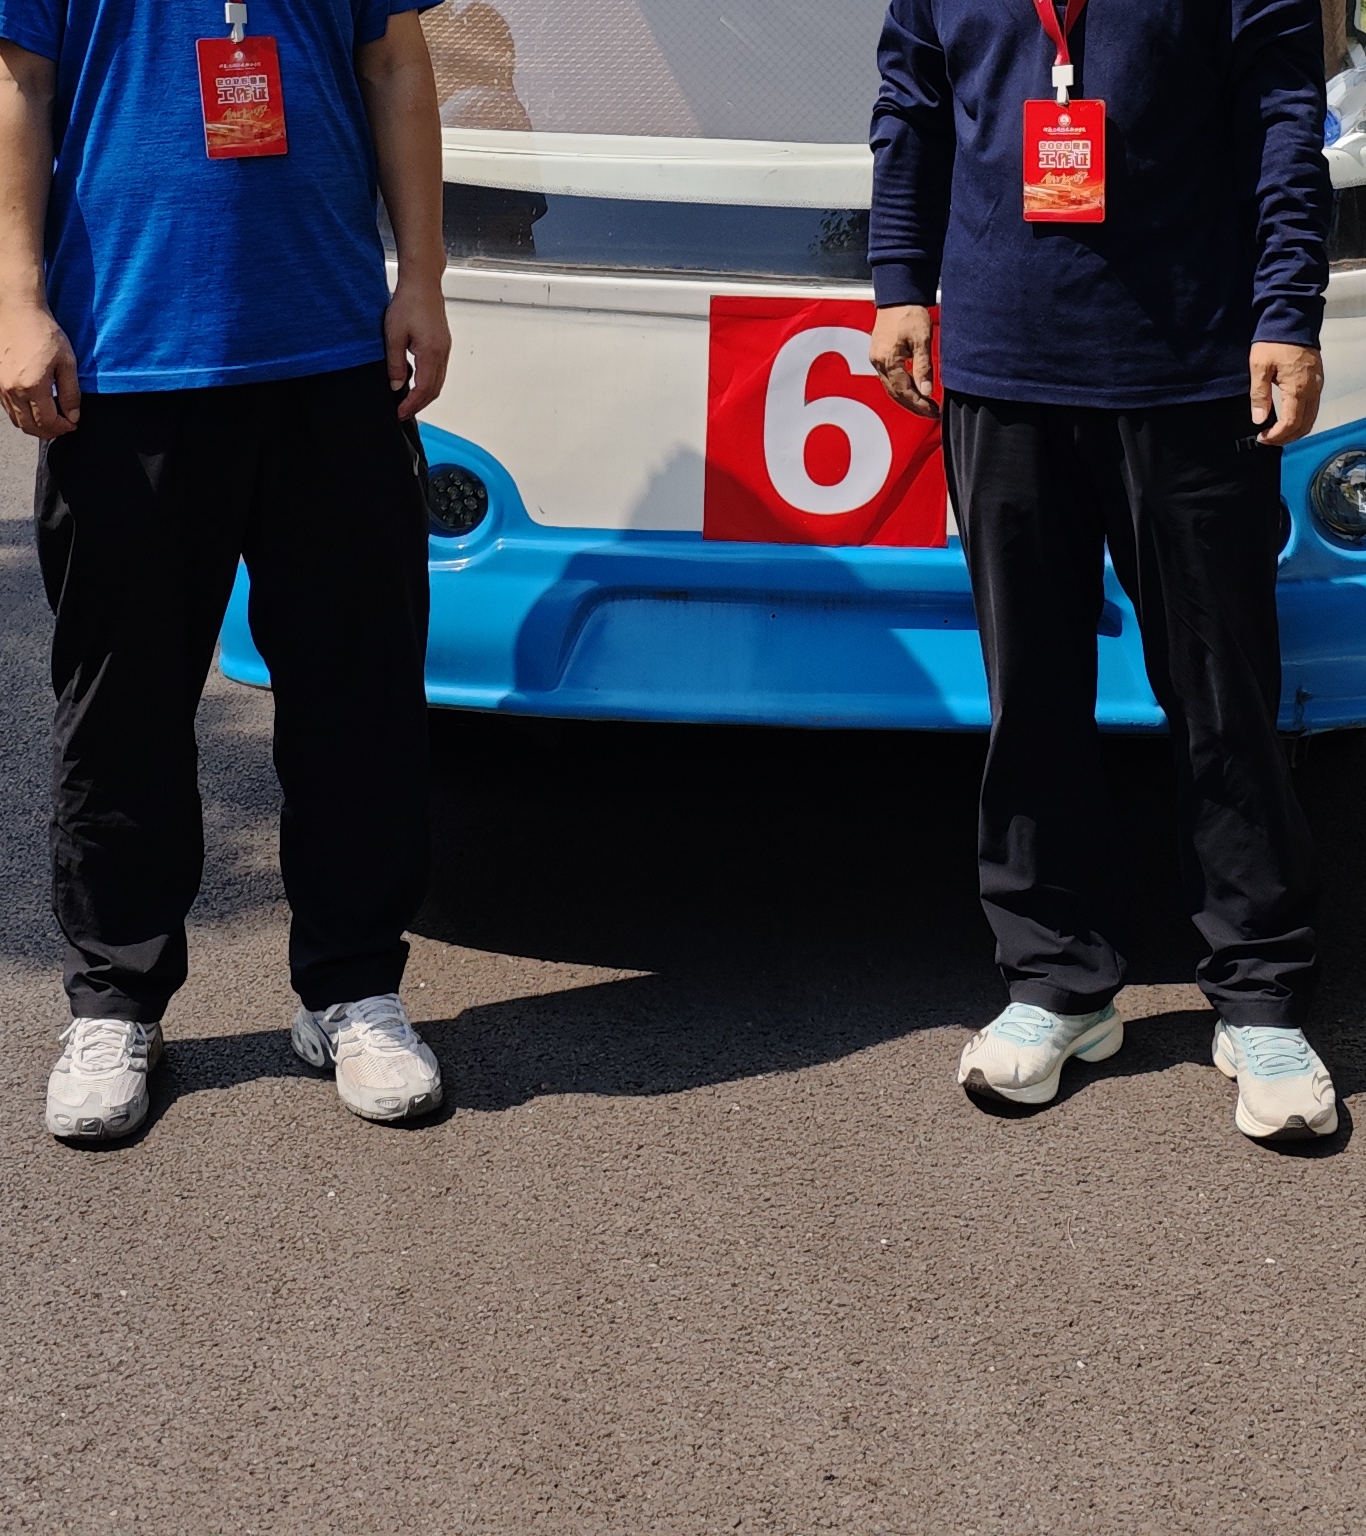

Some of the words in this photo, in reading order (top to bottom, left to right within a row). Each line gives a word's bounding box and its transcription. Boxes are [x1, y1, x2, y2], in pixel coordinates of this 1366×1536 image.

[218, 86, 269, 104] 工作证
[1039, 151, 1091, 168] 工作证
[763, 326, 893, 514] 6
